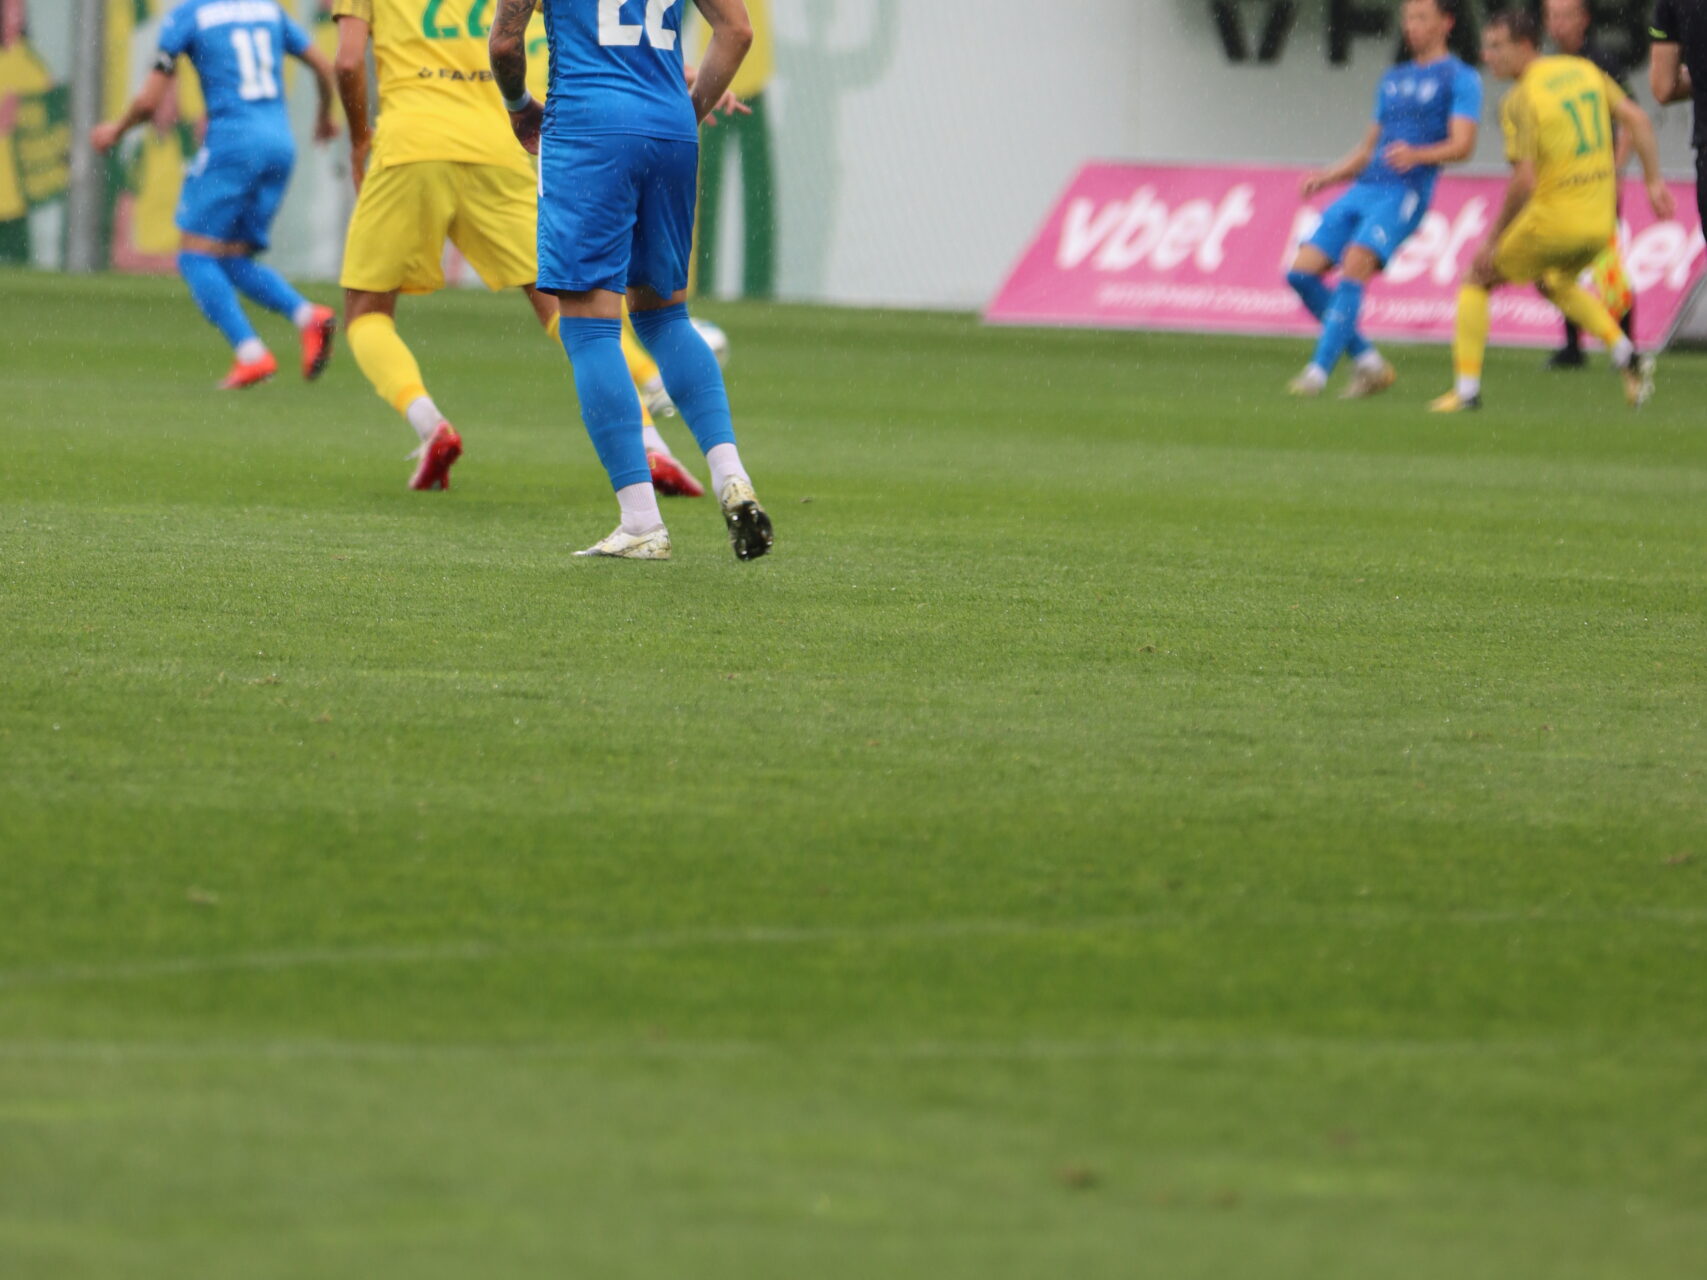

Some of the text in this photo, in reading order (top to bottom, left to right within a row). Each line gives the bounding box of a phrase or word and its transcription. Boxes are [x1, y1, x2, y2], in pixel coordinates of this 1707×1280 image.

[231, 27, 279, 101] 11
[1562, 91, 1604, 157] 17
[1056, 183, 1255, 272] vbet
